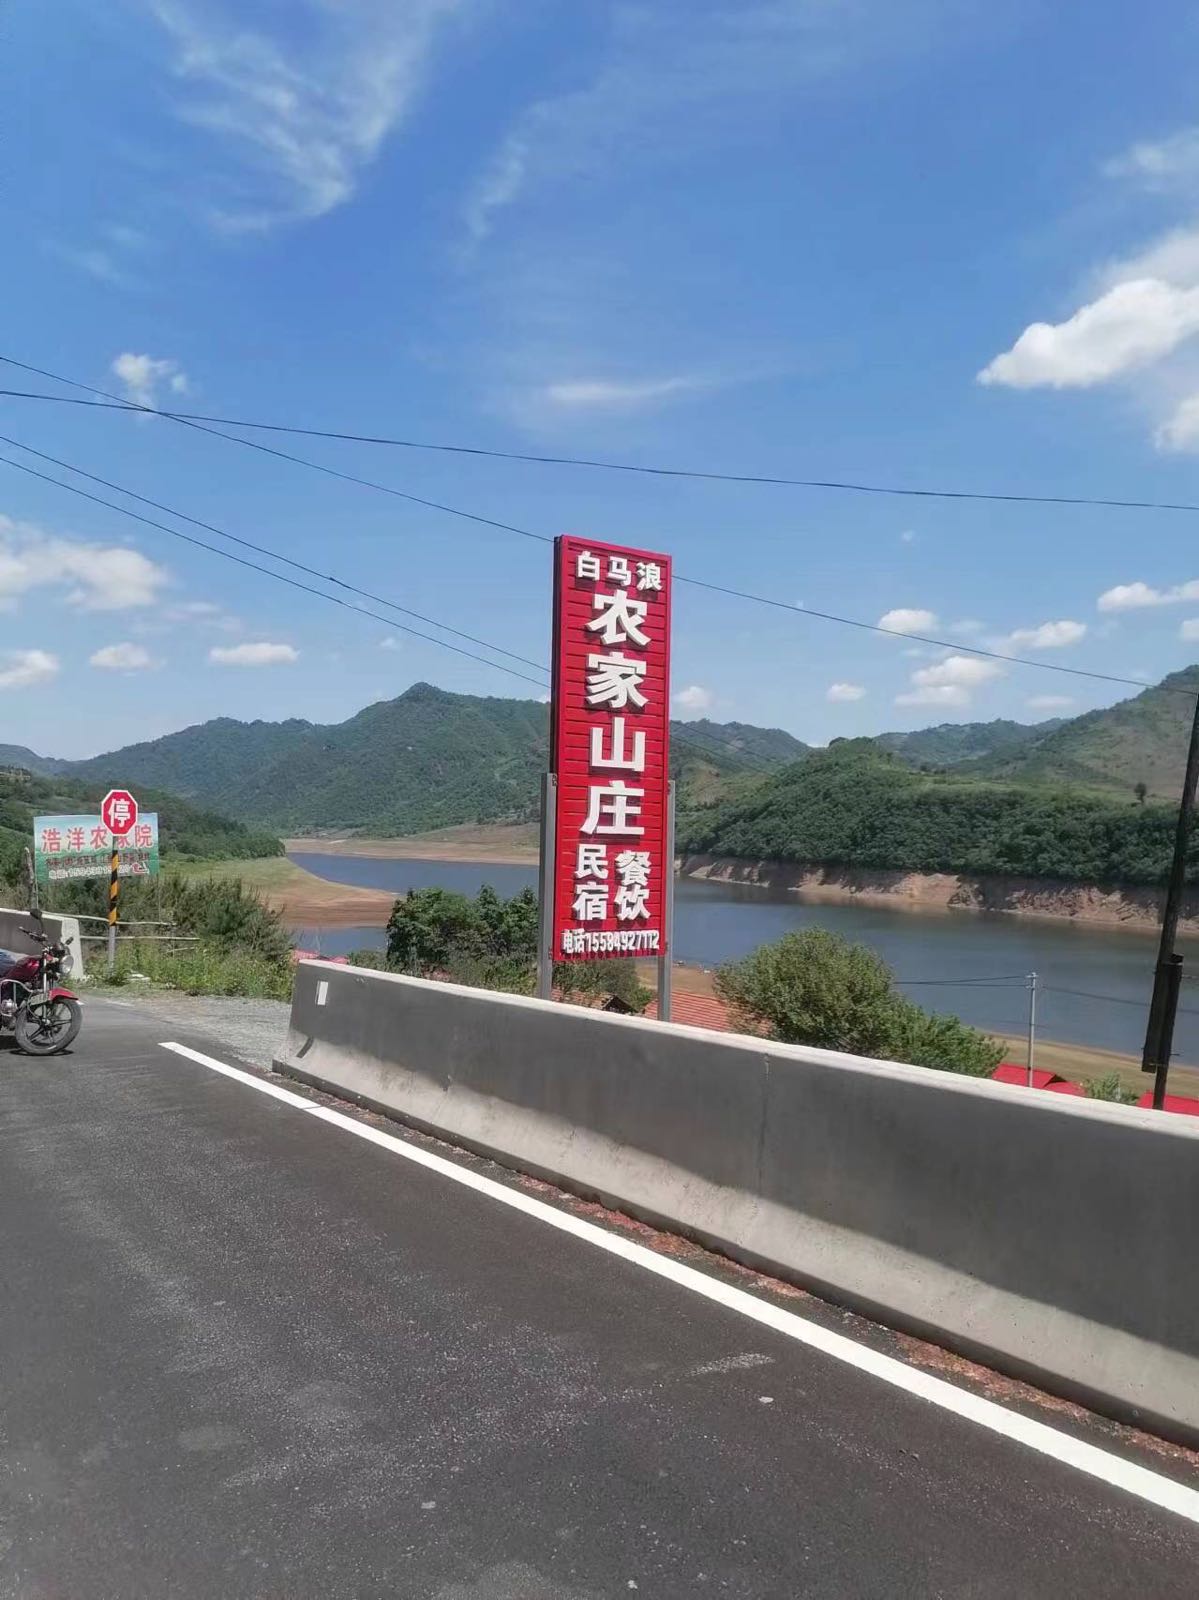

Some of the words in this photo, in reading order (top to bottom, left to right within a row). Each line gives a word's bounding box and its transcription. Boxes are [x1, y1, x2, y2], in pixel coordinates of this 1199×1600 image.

[577, 550, 663, 591] 白马浪
[581, 589, 652, 836] 农家山庄
[108, 798, 131, 828] 停
[572, 843, 609, 921] 民宿
[614, 850, 651, 921] 餐饮
